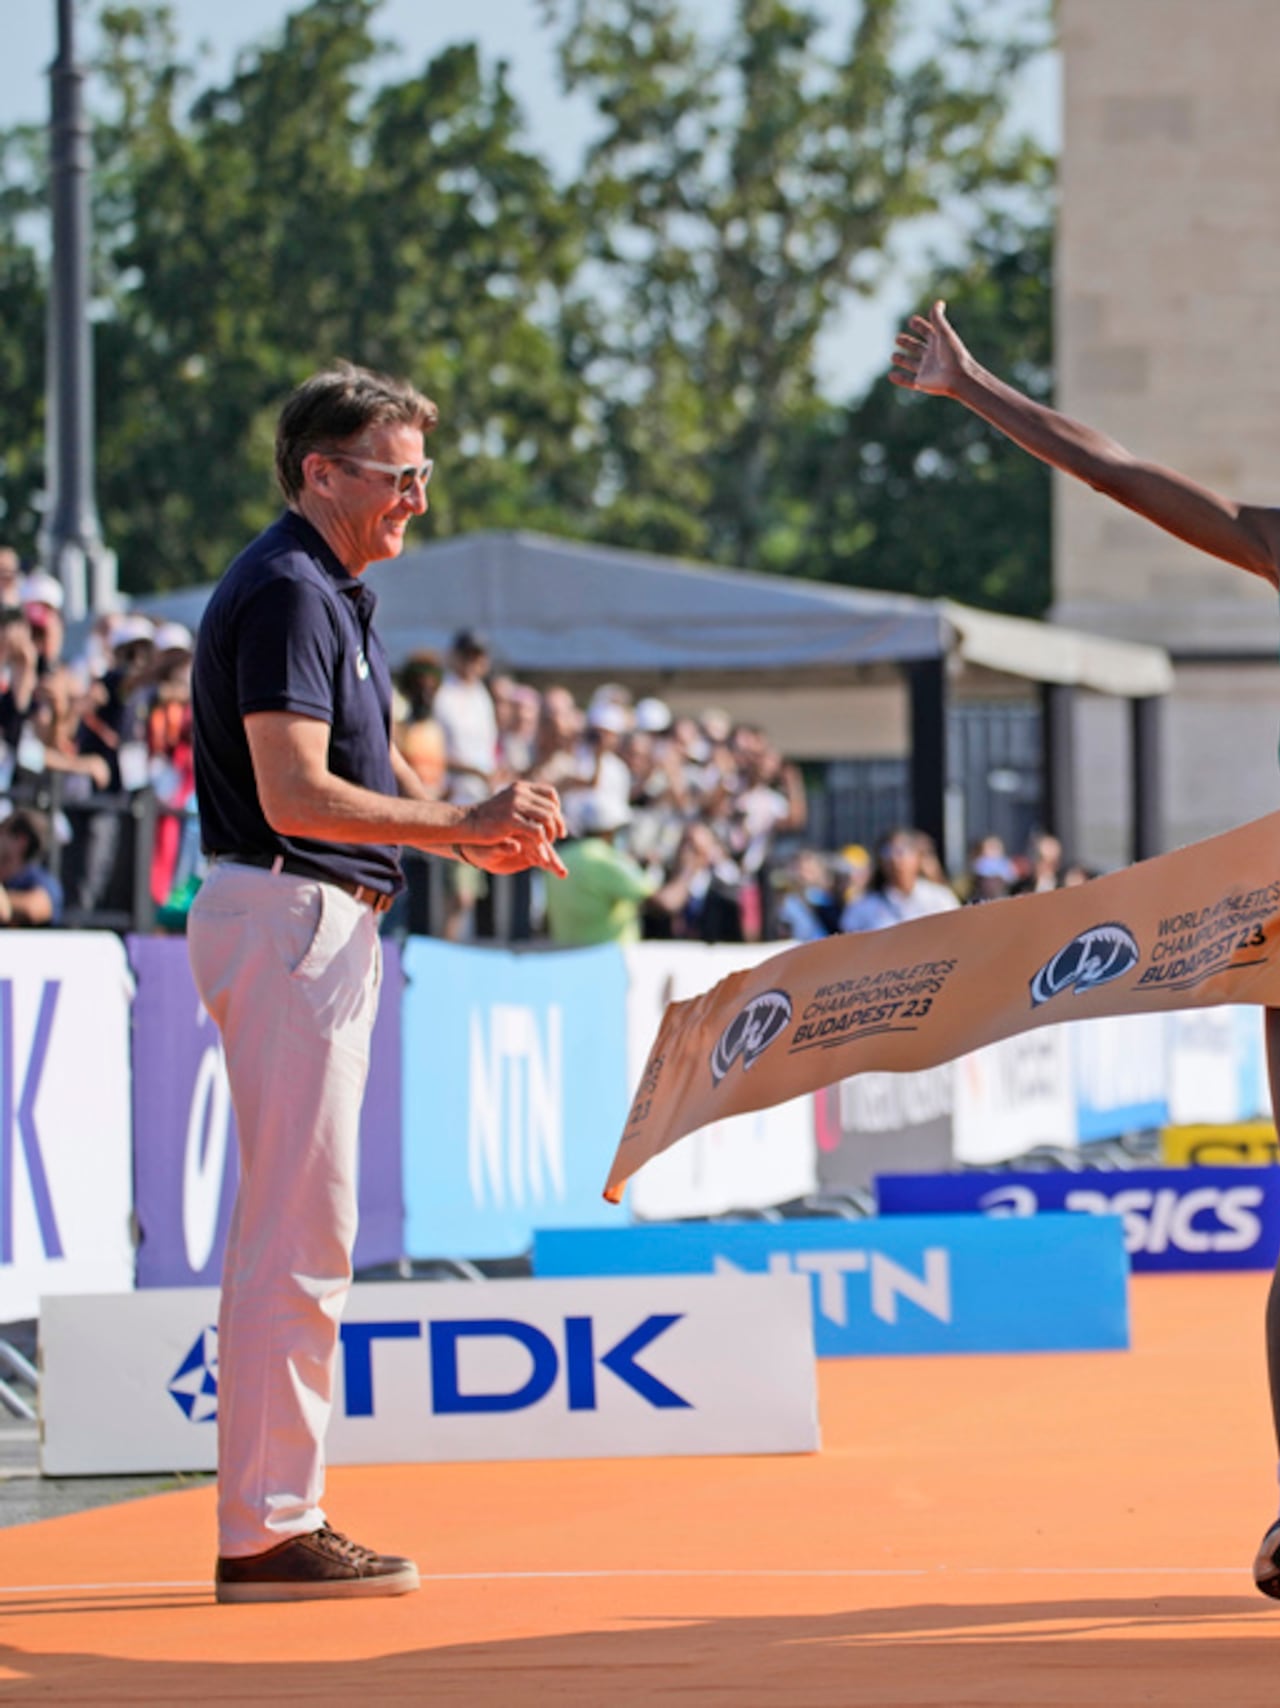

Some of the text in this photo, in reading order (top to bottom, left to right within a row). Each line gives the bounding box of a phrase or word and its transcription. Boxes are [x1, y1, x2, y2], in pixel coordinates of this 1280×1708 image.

[1157, 907, 1210, 938] WORLD
[1138, 923, 1267, 984] BUDAPEST 23
[802, 977, 945, 1020] CHAMPIONSHIPS
[815, 959, 958, 999] WORLD ATHLETICS
[792, 998, 933, 1045] BUDAPEST 23
[468, 1003, 565, 1206] NTN
[340, 1313, 695, 1419] TDK
